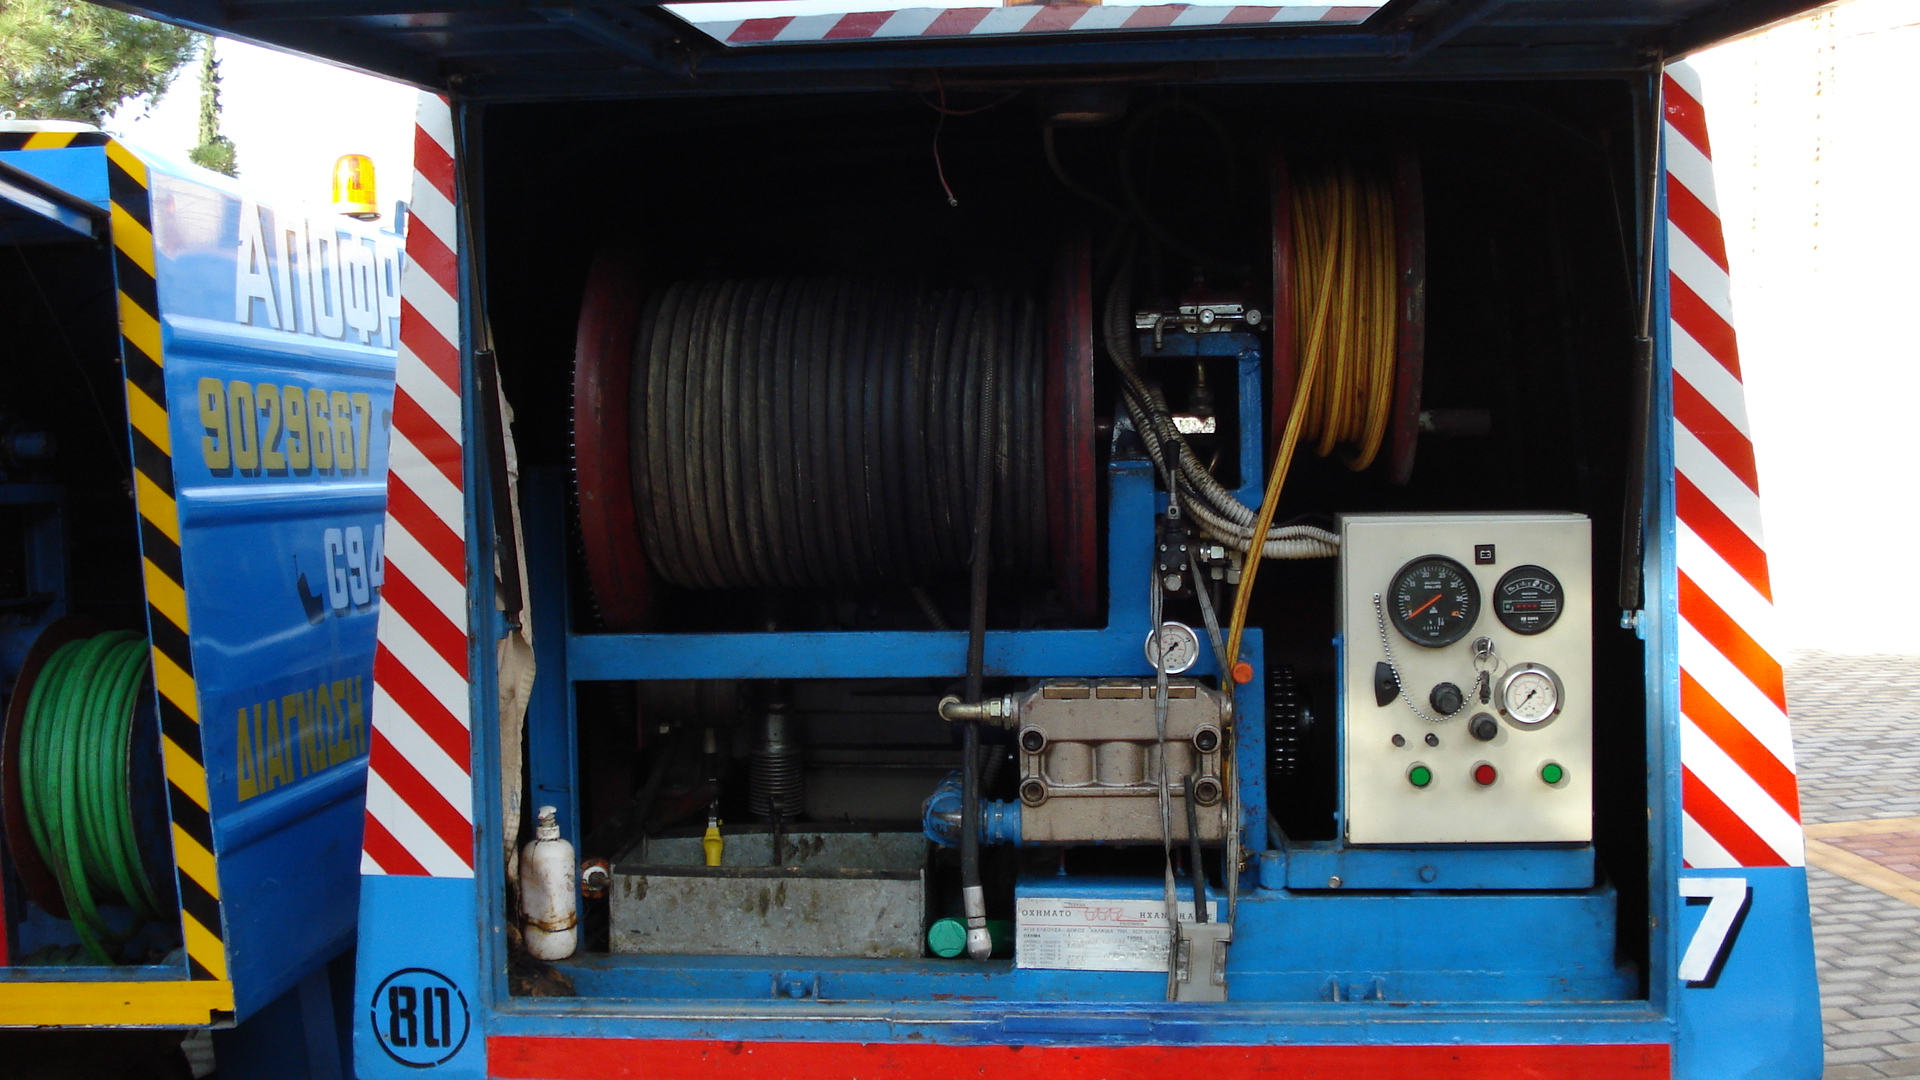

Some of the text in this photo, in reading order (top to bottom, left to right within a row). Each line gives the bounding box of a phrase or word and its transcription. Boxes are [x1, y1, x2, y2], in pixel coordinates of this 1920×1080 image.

[197, 377, 372, 475] 9029667
[237, 675, 366, 803] ΔΙΑΓΝΩΣΗ
[1677, 877, 1752, 988] 7
[388, 986, 451, 1047] 80
